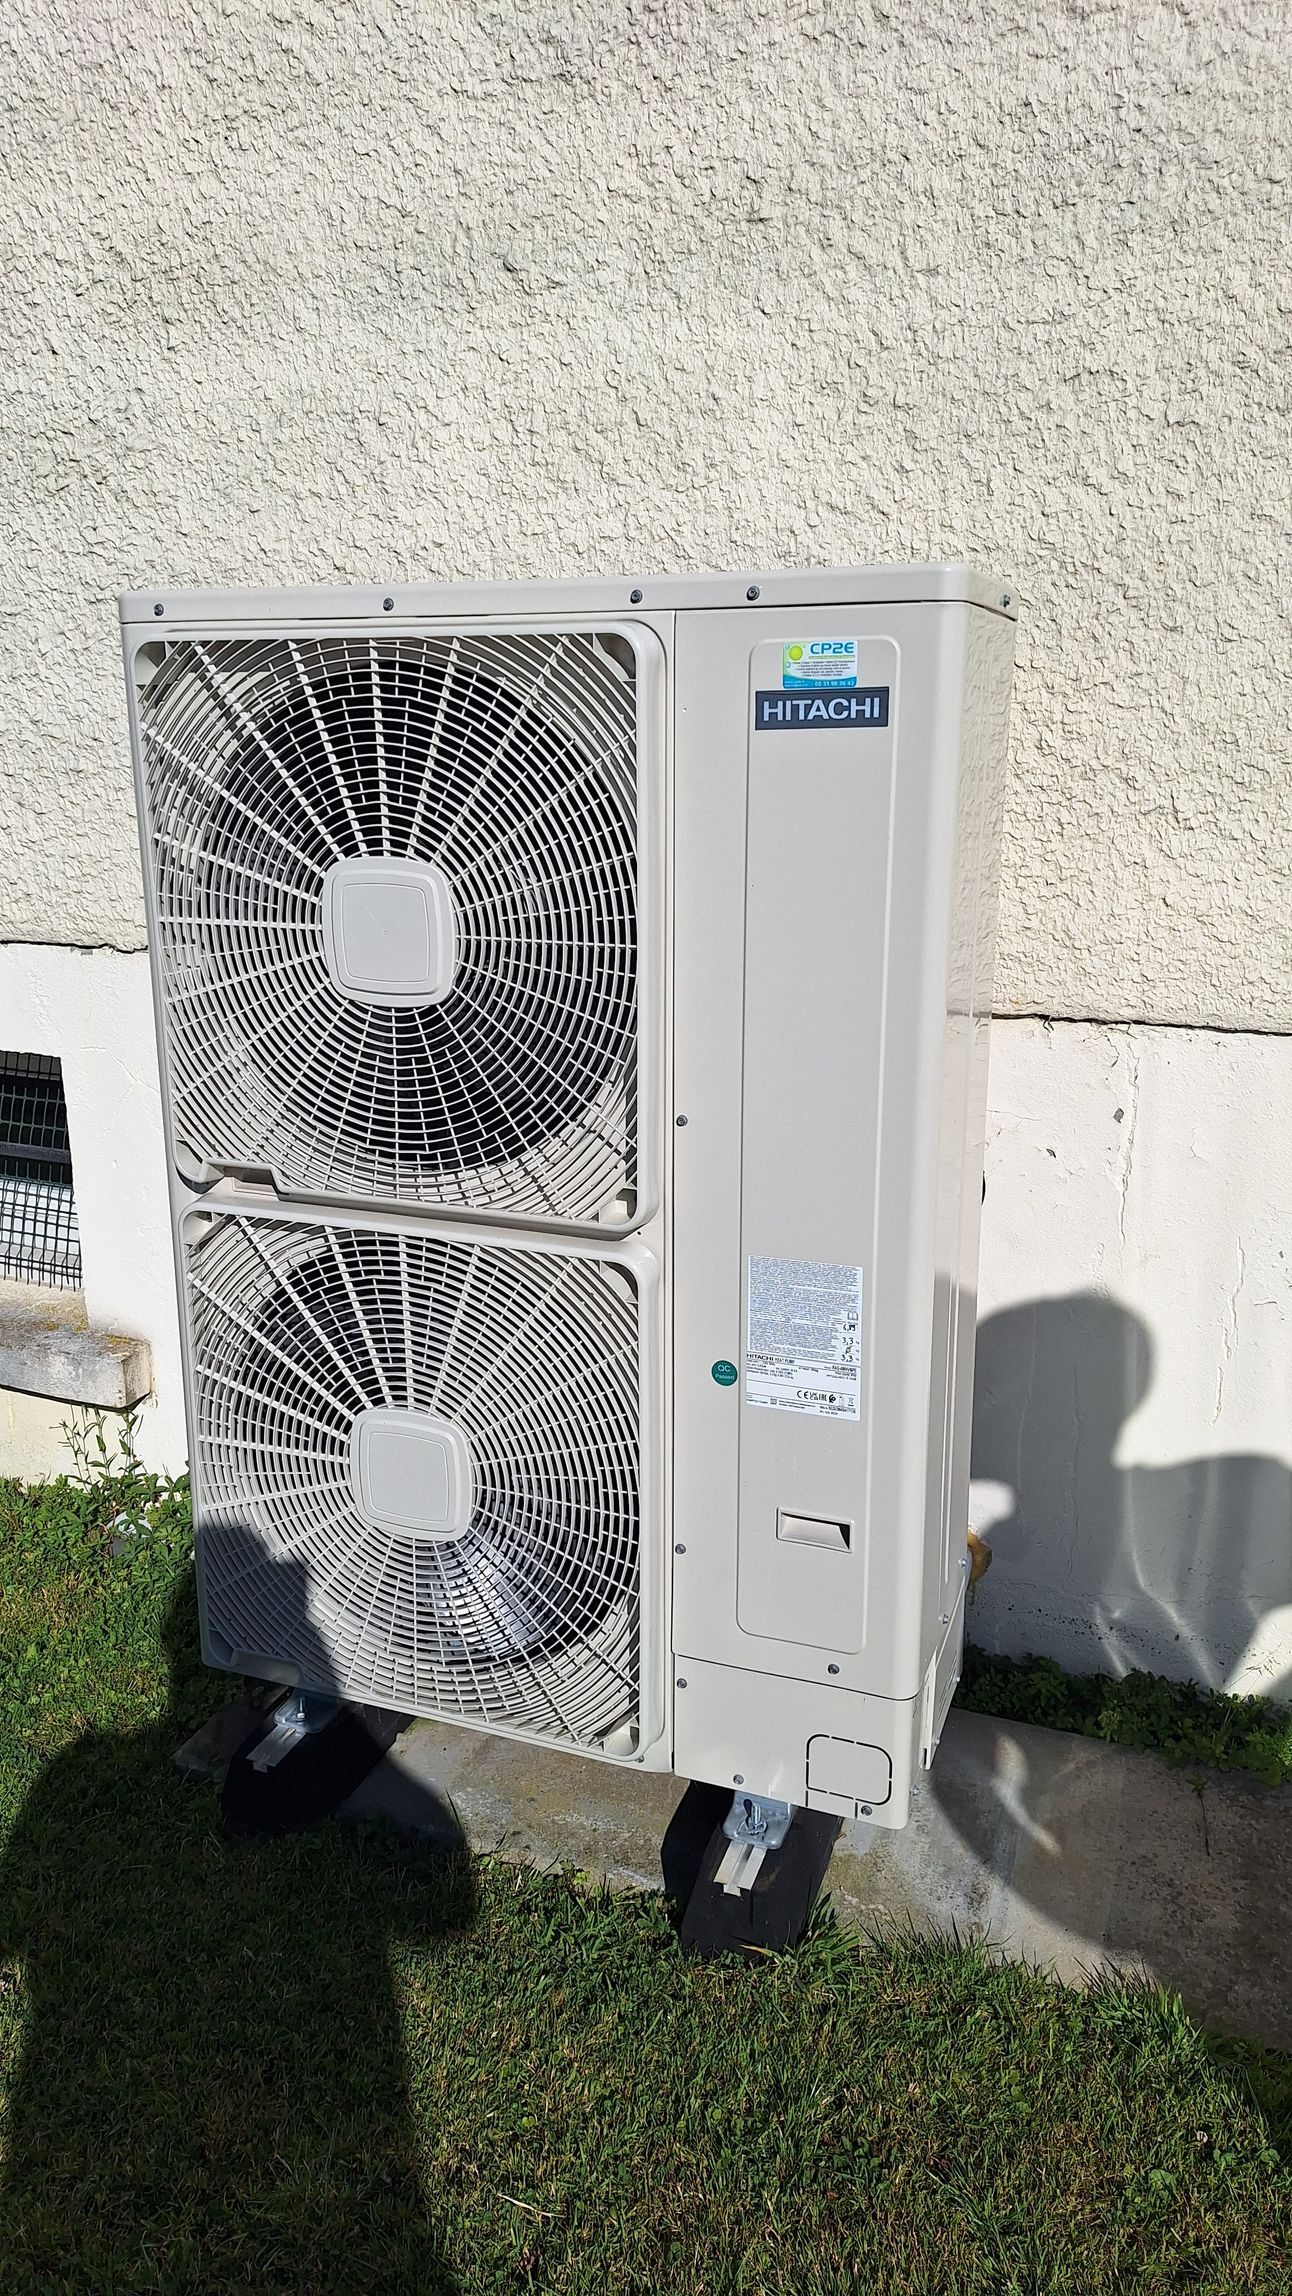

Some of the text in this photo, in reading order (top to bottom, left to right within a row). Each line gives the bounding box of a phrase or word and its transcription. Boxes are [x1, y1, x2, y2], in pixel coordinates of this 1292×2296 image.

[810, 642, 854, 654] CP2E
[763, 697, 880, 721] HITACHI
[746, 1353, 774, 1362] HITACHI
[717, 1364, 731, 1373] QC
